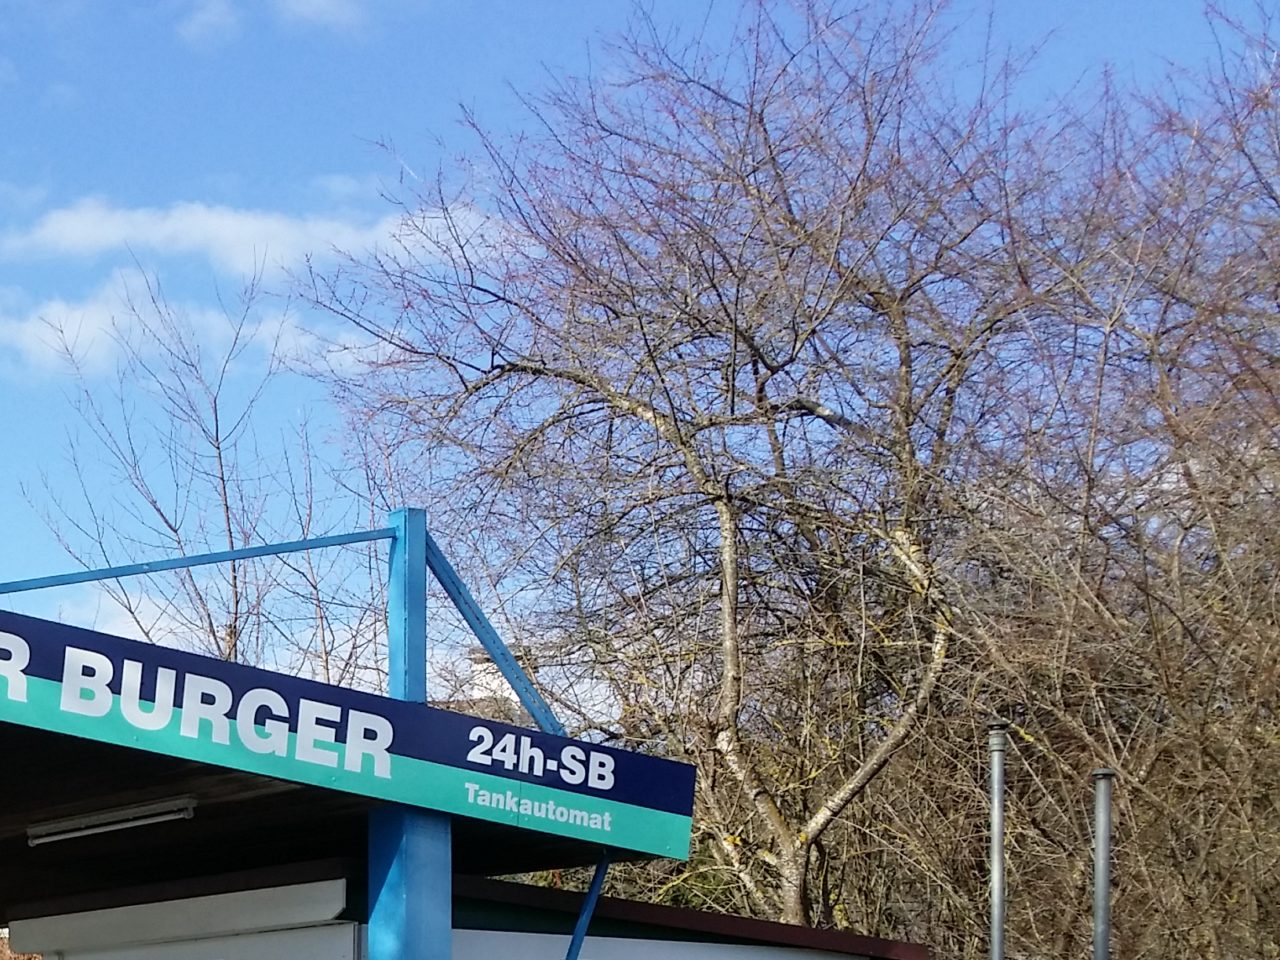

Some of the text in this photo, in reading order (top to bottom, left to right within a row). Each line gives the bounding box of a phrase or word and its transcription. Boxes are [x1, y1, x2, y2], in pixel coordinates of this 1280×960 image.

[60, 646, 394, 779] BURGER
[466, 726, 616, 791] 24h-SB
[464, 782, 612, 832] Tankautomat
